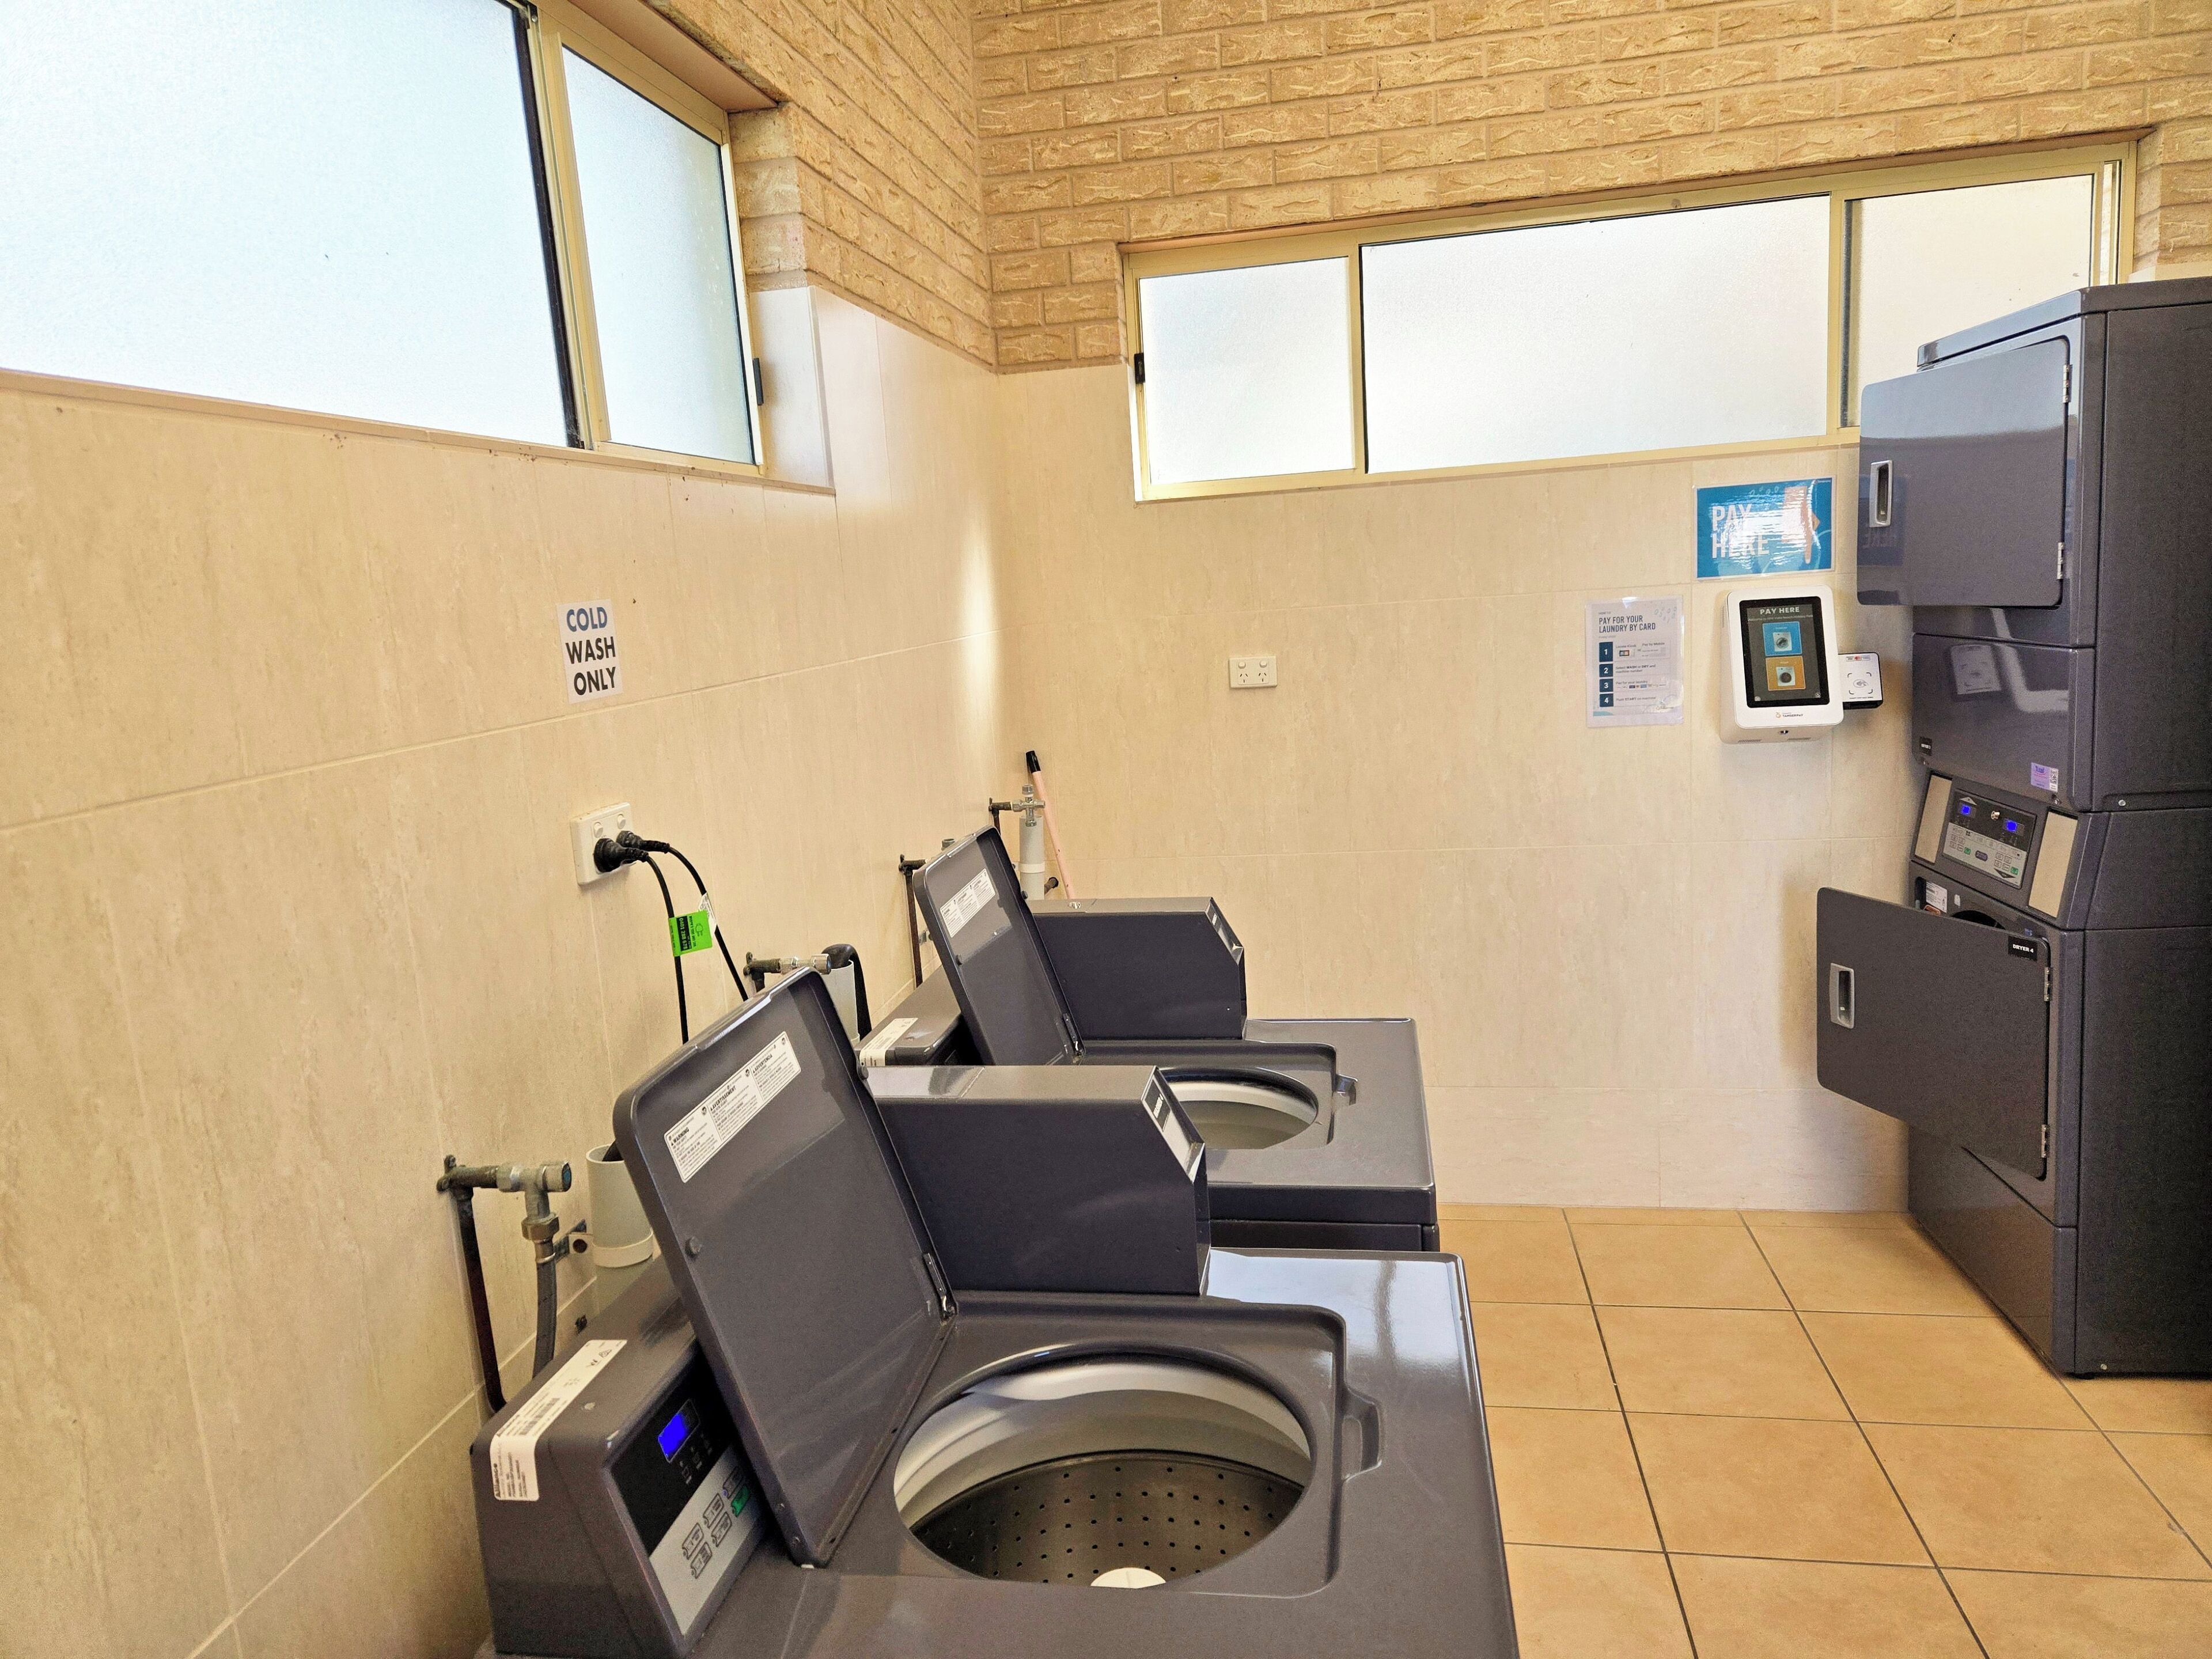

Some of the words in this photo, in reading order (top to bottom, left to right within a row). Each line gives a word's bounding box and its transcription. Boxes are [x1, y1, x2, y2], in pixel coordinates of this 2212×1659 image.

[1712, 503, 1752, 531] PAY
[1712, 531, 1770, 558] HERE
[566, 607, 608, 632] COLD
[1599, 617, 1611, 625] PAY
[1599, 624, 1628, 633] LAUNDRY
[1629, 623, 1638, 631] BY
[1639, 623, 1656, 631] CARD
[565, 636, 616, 664] WASH
[574, 666, 616, 696] ONLY
[2013, 944, 2029, 952] DRYER
